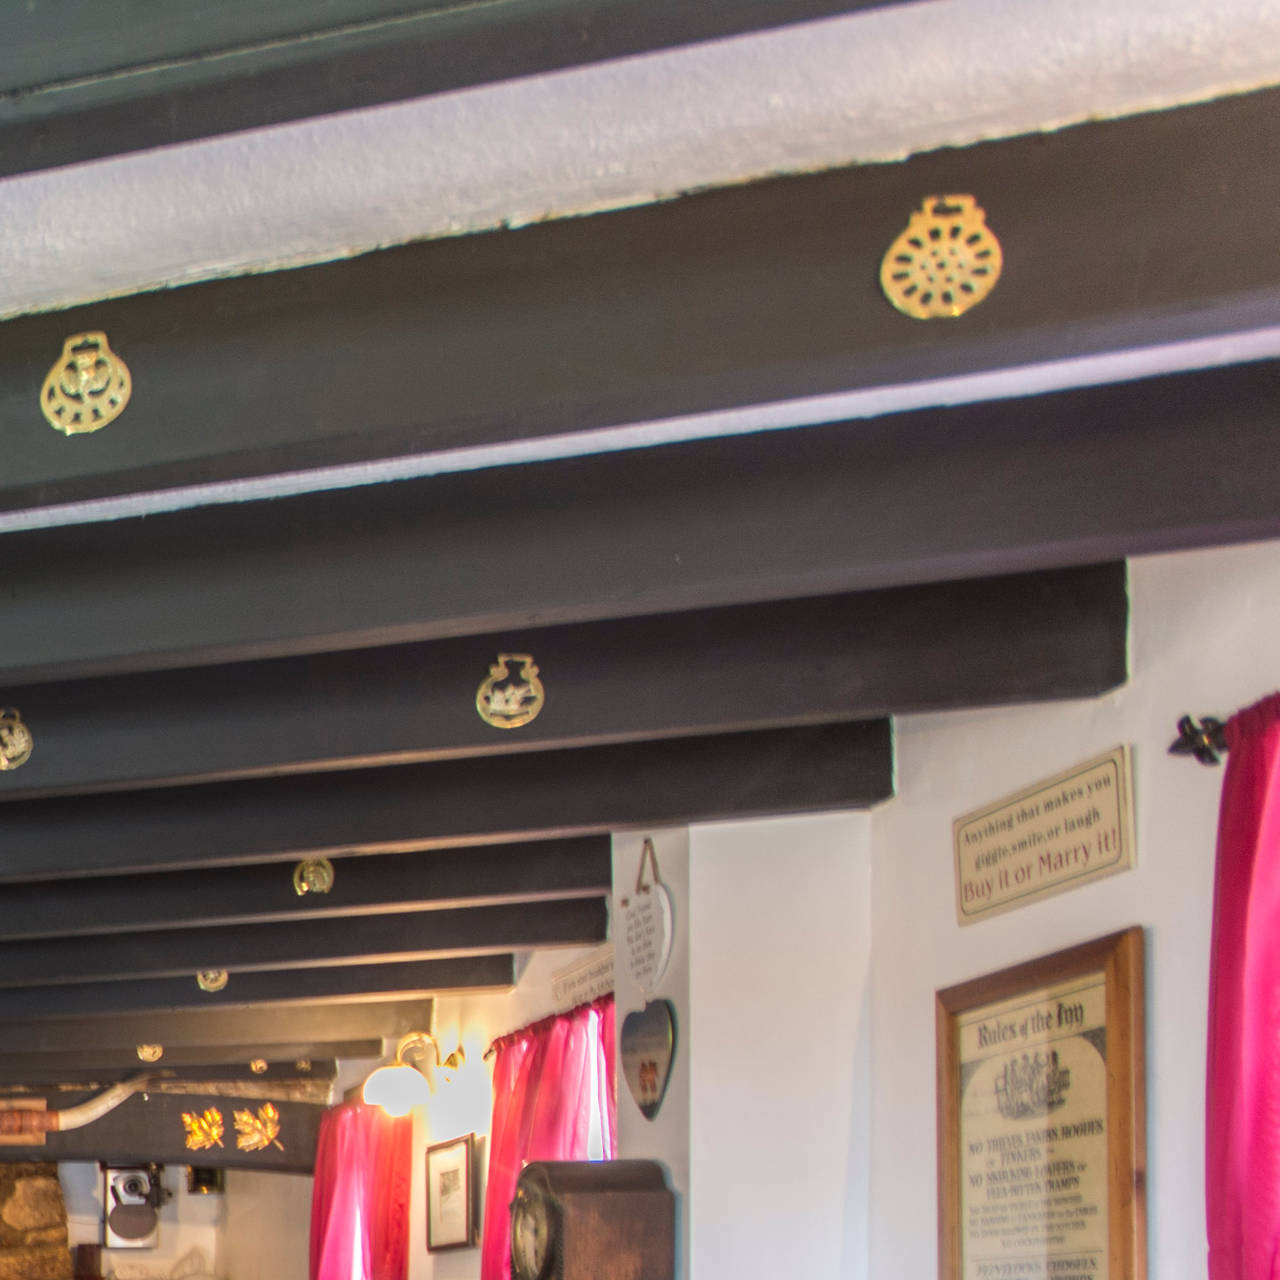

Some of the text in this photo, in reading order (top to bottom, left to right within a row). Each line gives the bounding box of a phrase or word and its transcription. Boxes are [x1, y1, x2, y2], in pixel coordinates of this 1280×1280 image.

[964, 774, 1111, 846] Anything that makes you
[1064, 806, 1100, 833] laugh
[964, 827, 1117, 902] Buy it or Marry it!
[977, 1022, 1017, 1049] Rules
[1031, 1008, 1053, 1032] the
[1057, 1002, 1084, 1028] Inn
